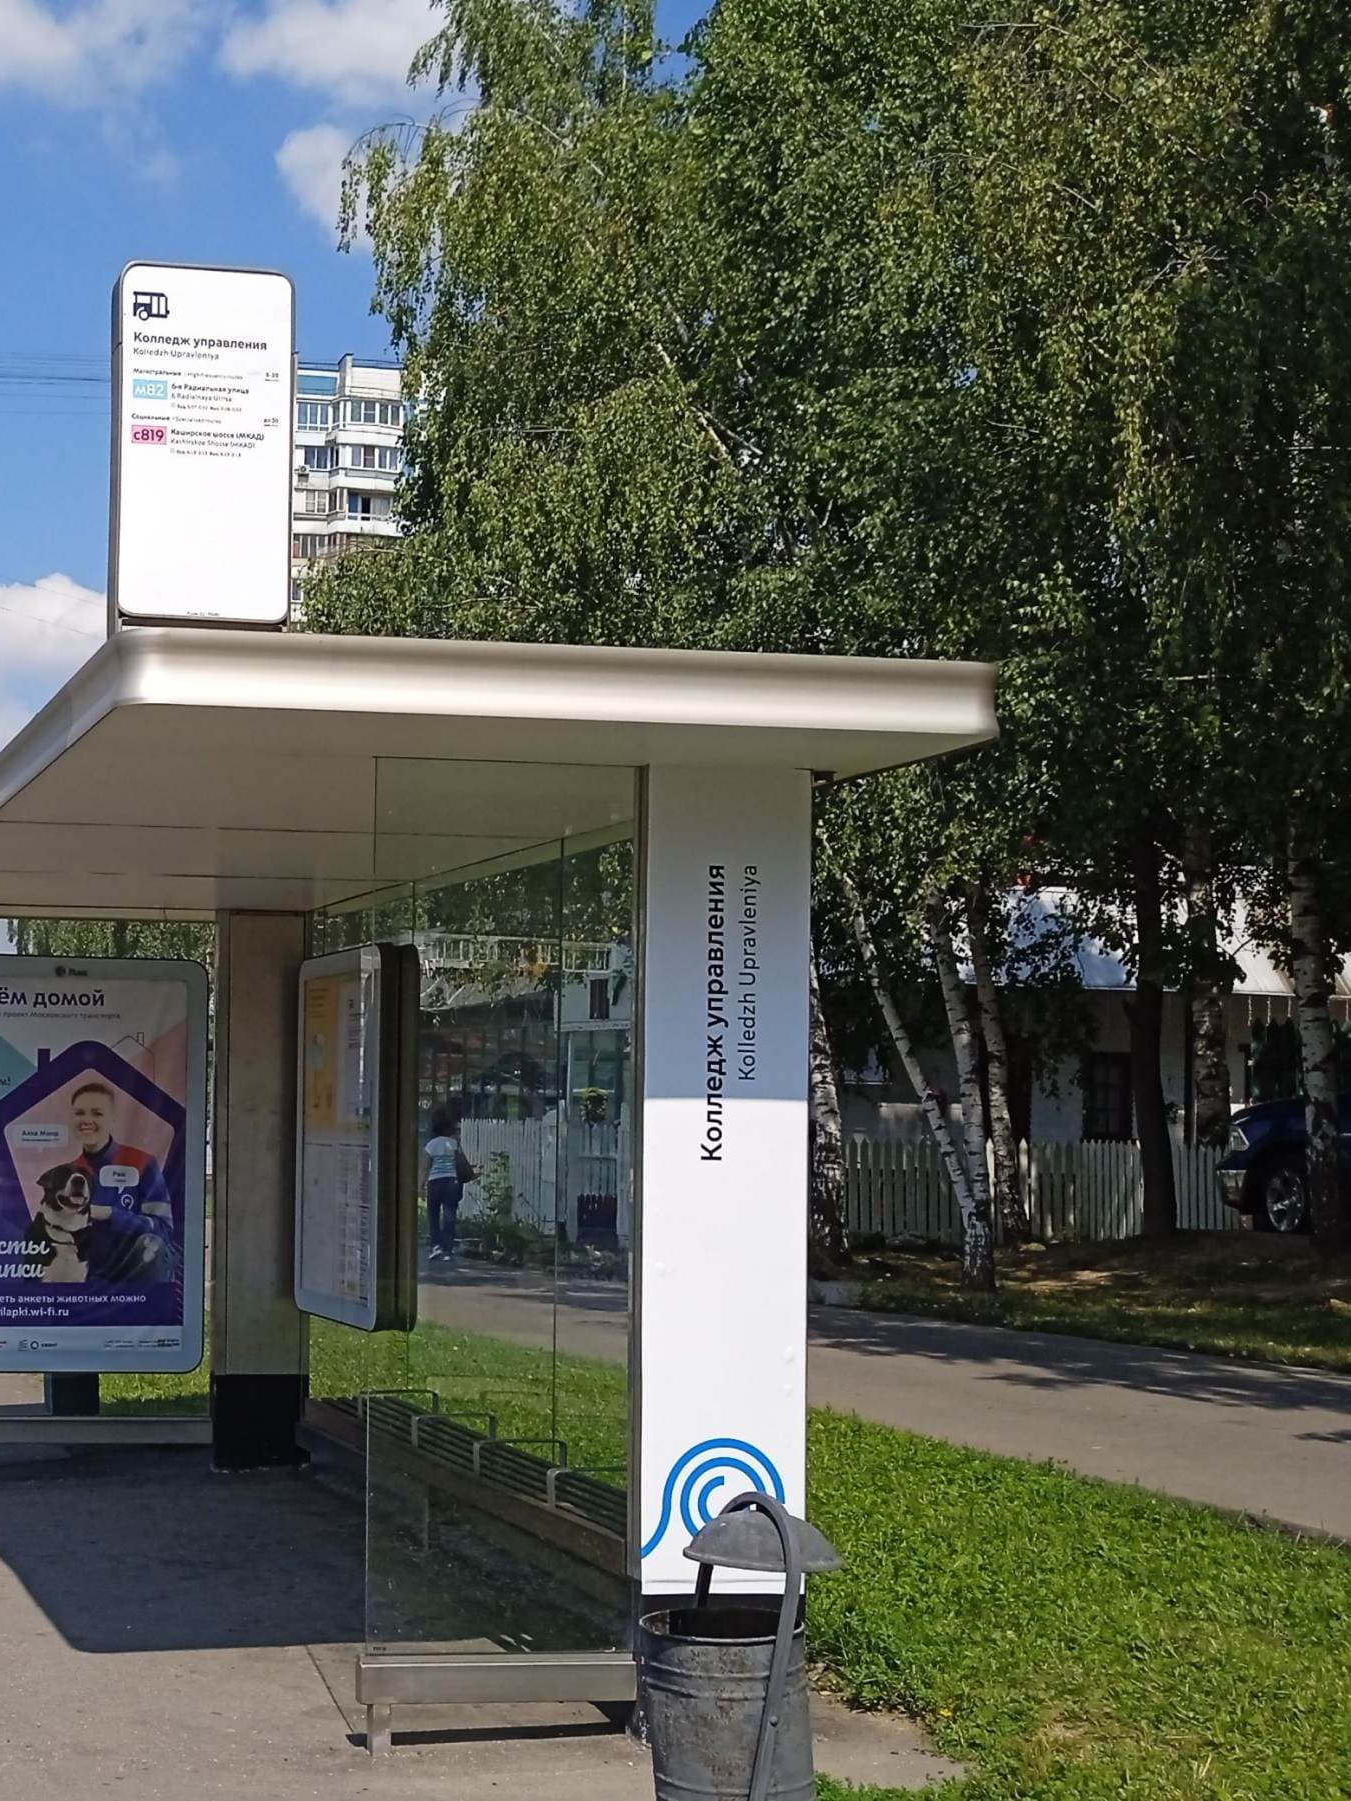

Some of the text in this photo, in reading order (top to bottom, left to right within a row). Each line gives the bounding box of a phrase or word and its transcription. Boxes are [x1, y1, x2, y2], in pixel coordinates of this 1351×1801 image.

[133, 332, 267, 351] Колледж управления
[133, 429, 164, 441] с819
[738, 865, 761, 1081] Kolledzh Upravleniya
[33, 989, 105, 1009] домой
[700, 864, 729, 1162] Колледж управления
[17, 1295, 55, 1303] анкеты
[56, 1295, 108, 1303] животных
[110, 1295, 147, 1303] можно
